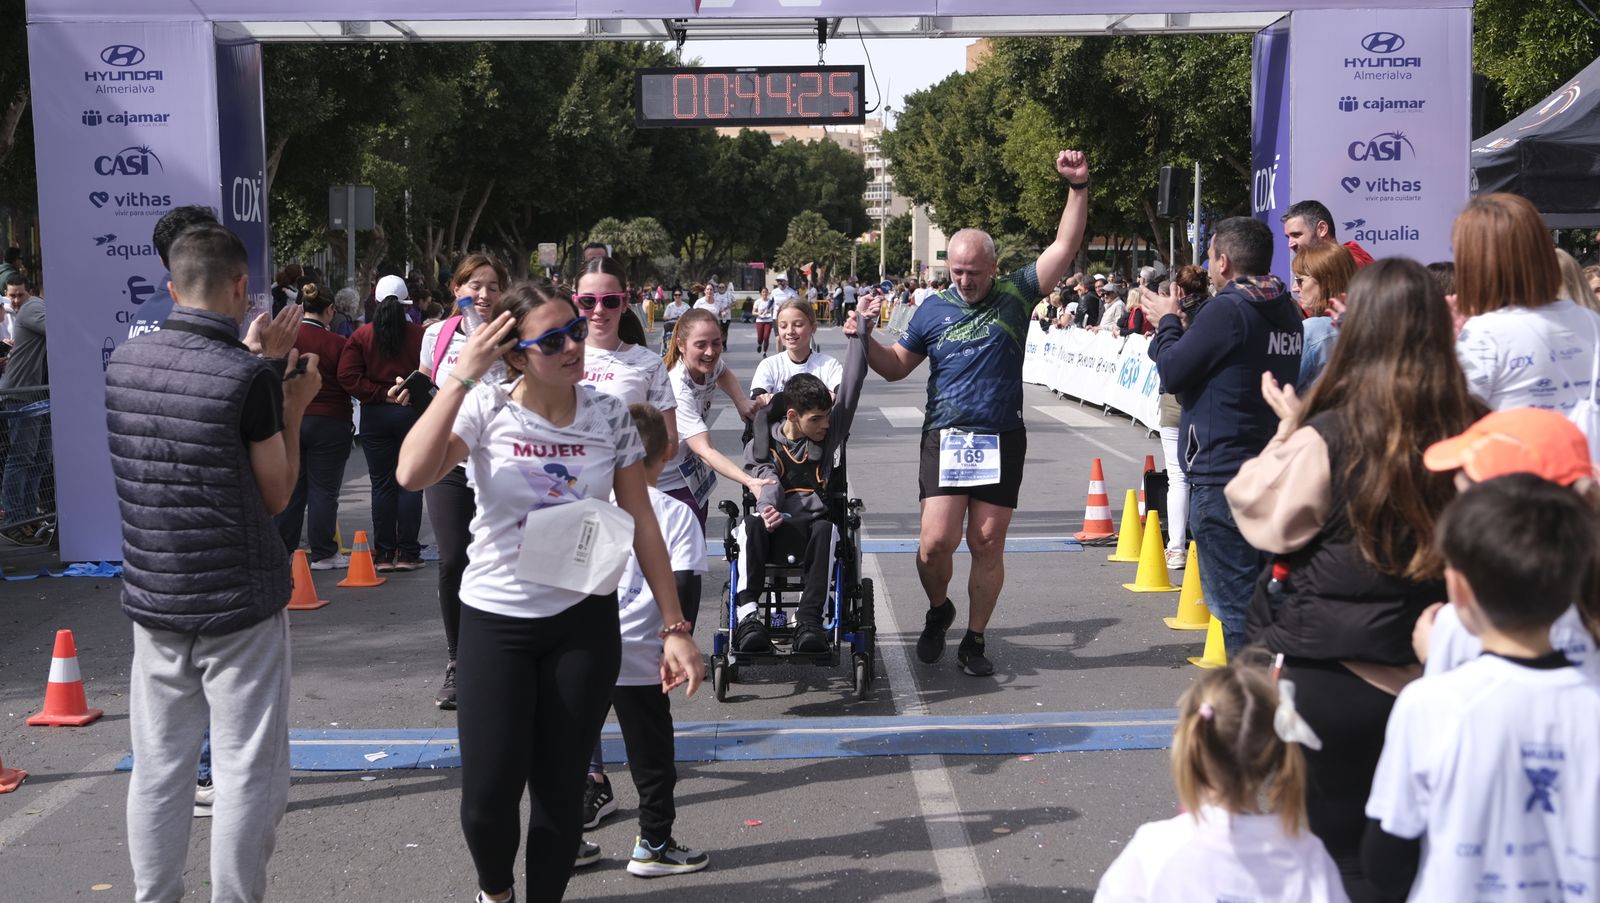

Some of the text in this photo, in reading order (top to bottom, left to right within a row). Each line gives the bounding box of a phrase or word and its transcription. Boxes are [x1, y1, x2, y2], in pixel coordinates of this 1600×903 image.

[1344, 57, 1421, 68] HYUNDAI
[84, 70, 163, 81] HYUNDAI
[1353, 70, 1412, 80] Almerialva
[95, 84, 155, 94] Almerialva
[673, 72, 854, 119] 00:44:25
[1363, 96, 1426, 113] cajamar
[106, 110, 170, 127] cajamar
[1347, 140, 1402, 161] CASI
[94, 155, 149, 176] CASI
[1365, 177, 1422, 193] vithas
[114, 191, 172, 208] vithas
[145, 209, 167, 217] cuidart
[1354, 225, 1420, 245] aqualia
[106, 241, 157, 260] aqual
[1267, 330, 1302, 355] NEXA
[513, 442, 586, 458] MUJER
[953, 449, 984, 464] 169
